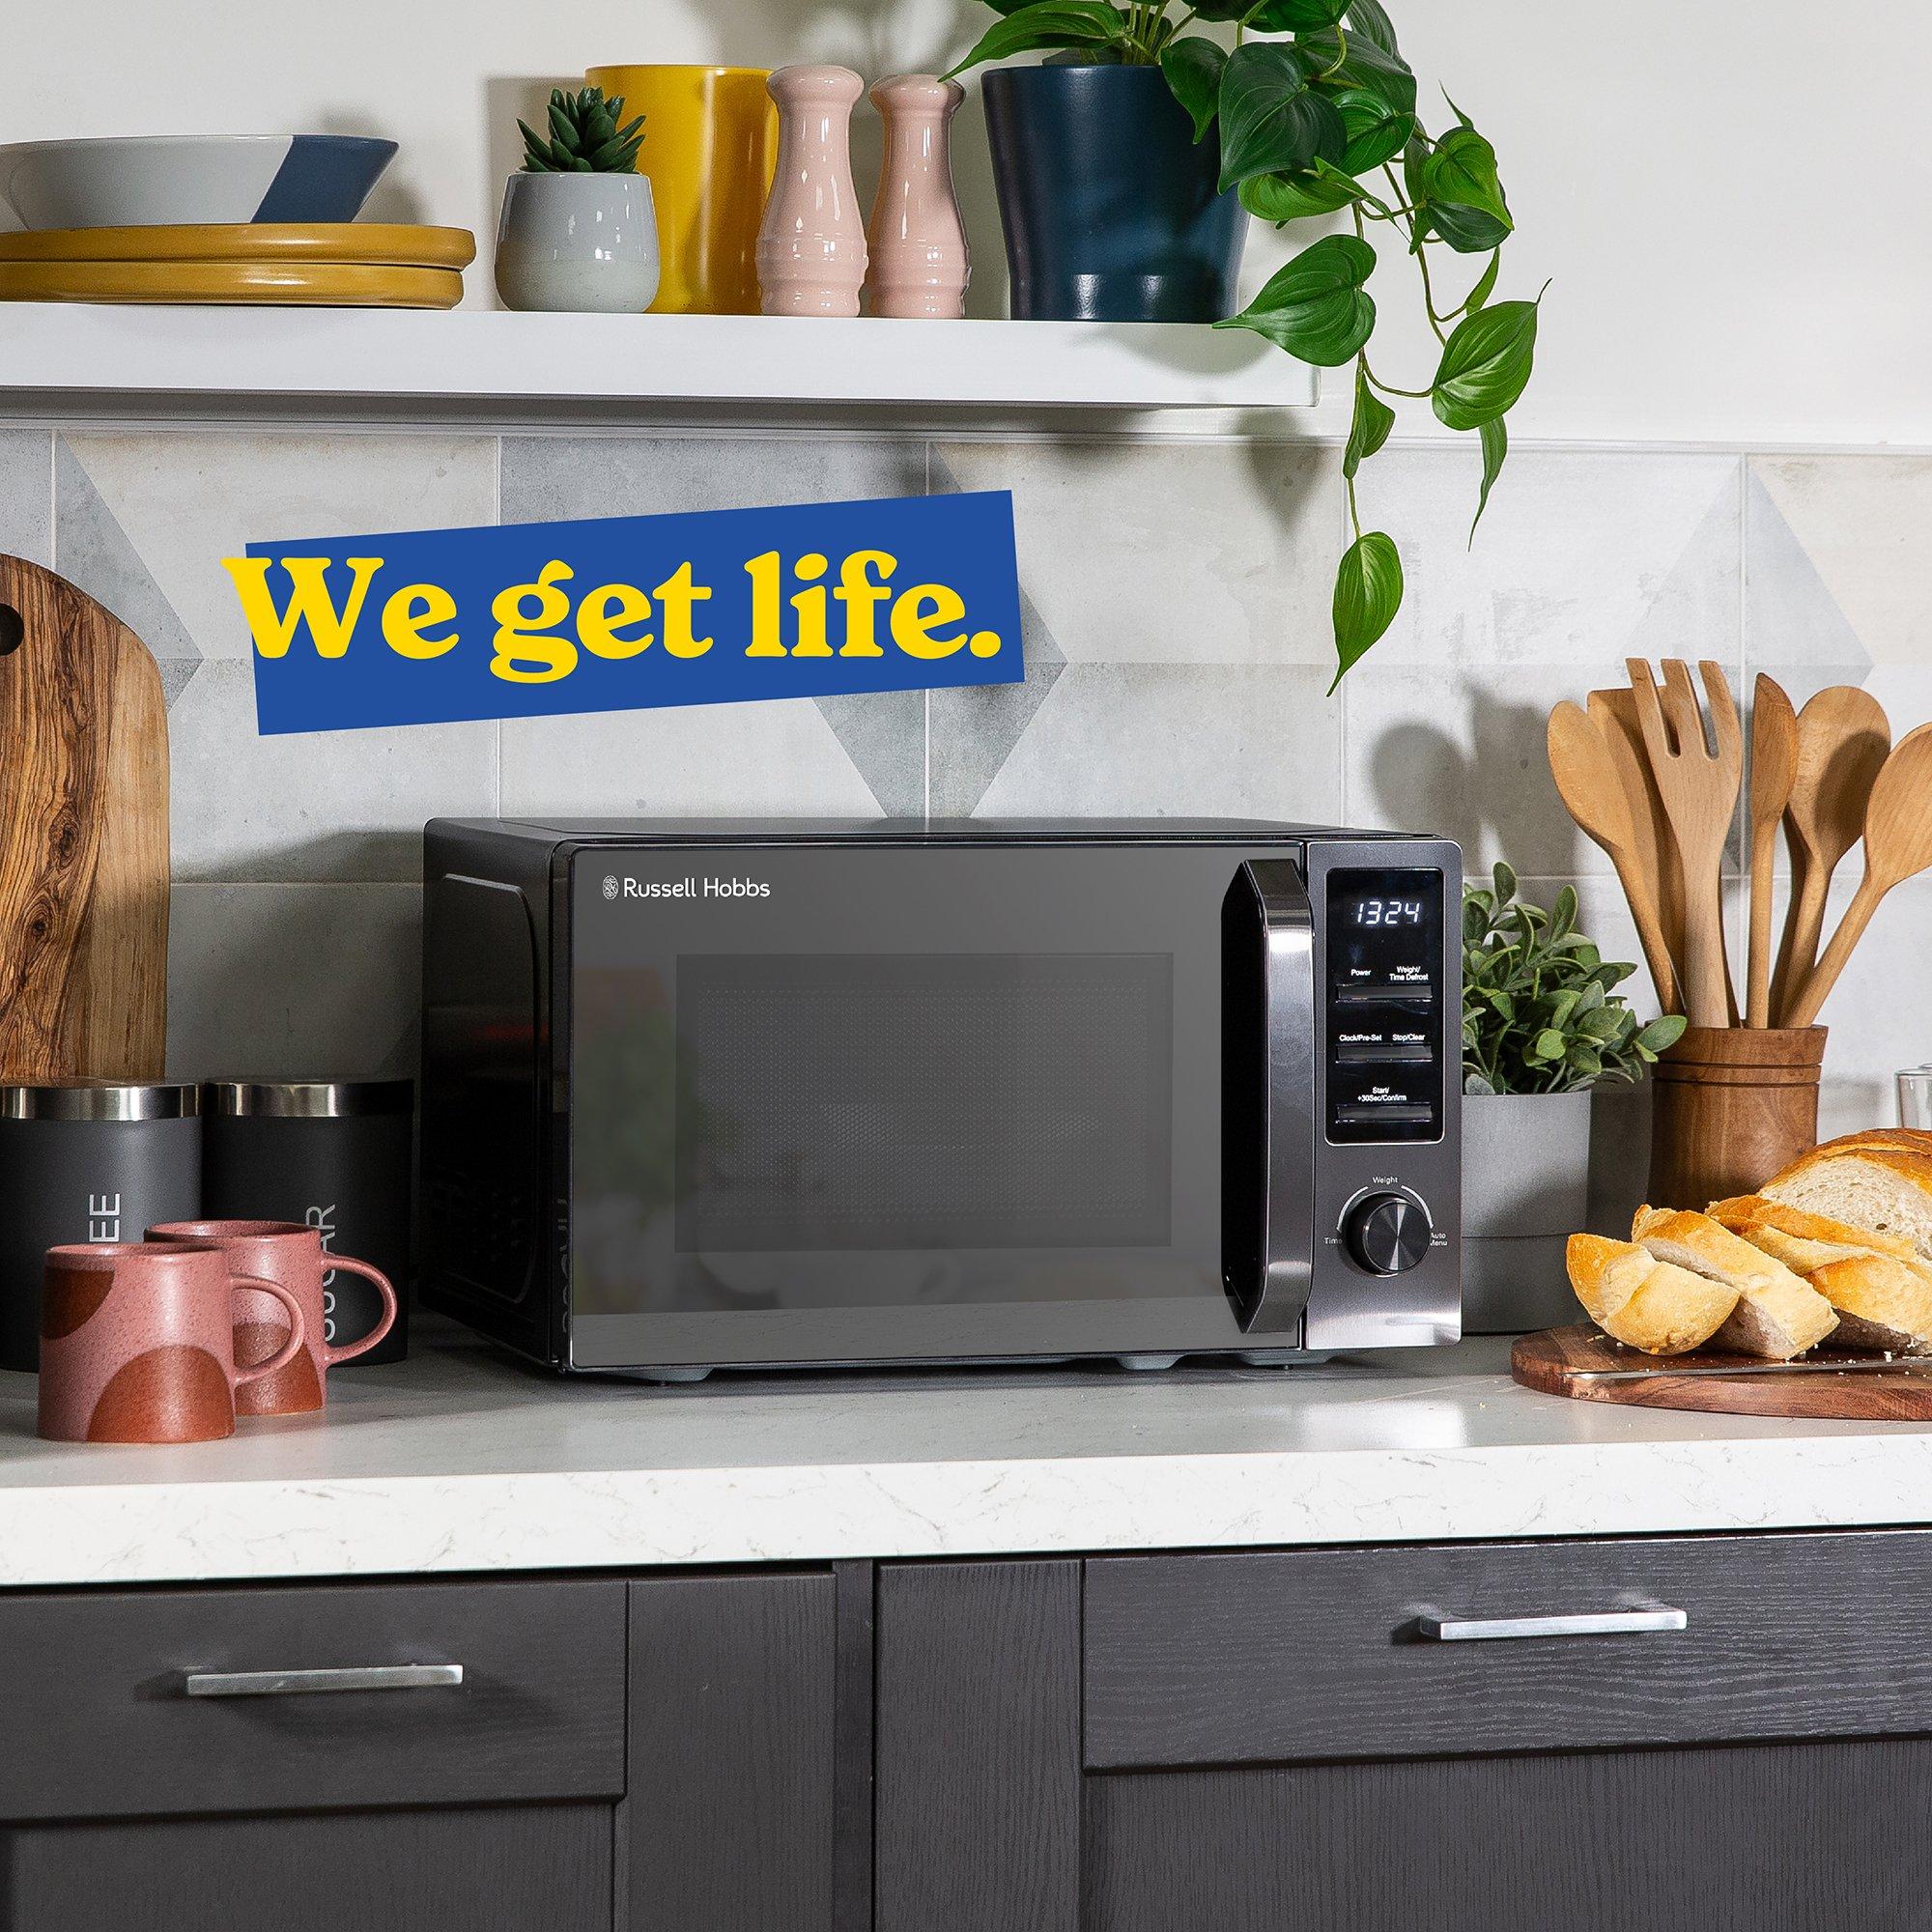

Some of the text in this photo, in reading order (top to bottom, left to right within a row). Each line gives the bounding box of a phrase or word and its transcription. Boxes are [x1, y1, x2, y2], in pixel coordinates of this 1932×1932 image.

[623, 877, 771, 898] Russell Hobbs
[1357, 900, 1421, 925] 1324
[1350, 968, 1372, 977] Power
[1389, 973, 1429, 981] Time Defrost
[1339, 1033, 1426, 1042] Clock/Pre-Set Stop/Clear
[1372, 1086, 1390, 1094] Start/
[1372, 1176, 1398, 1184] Weight
